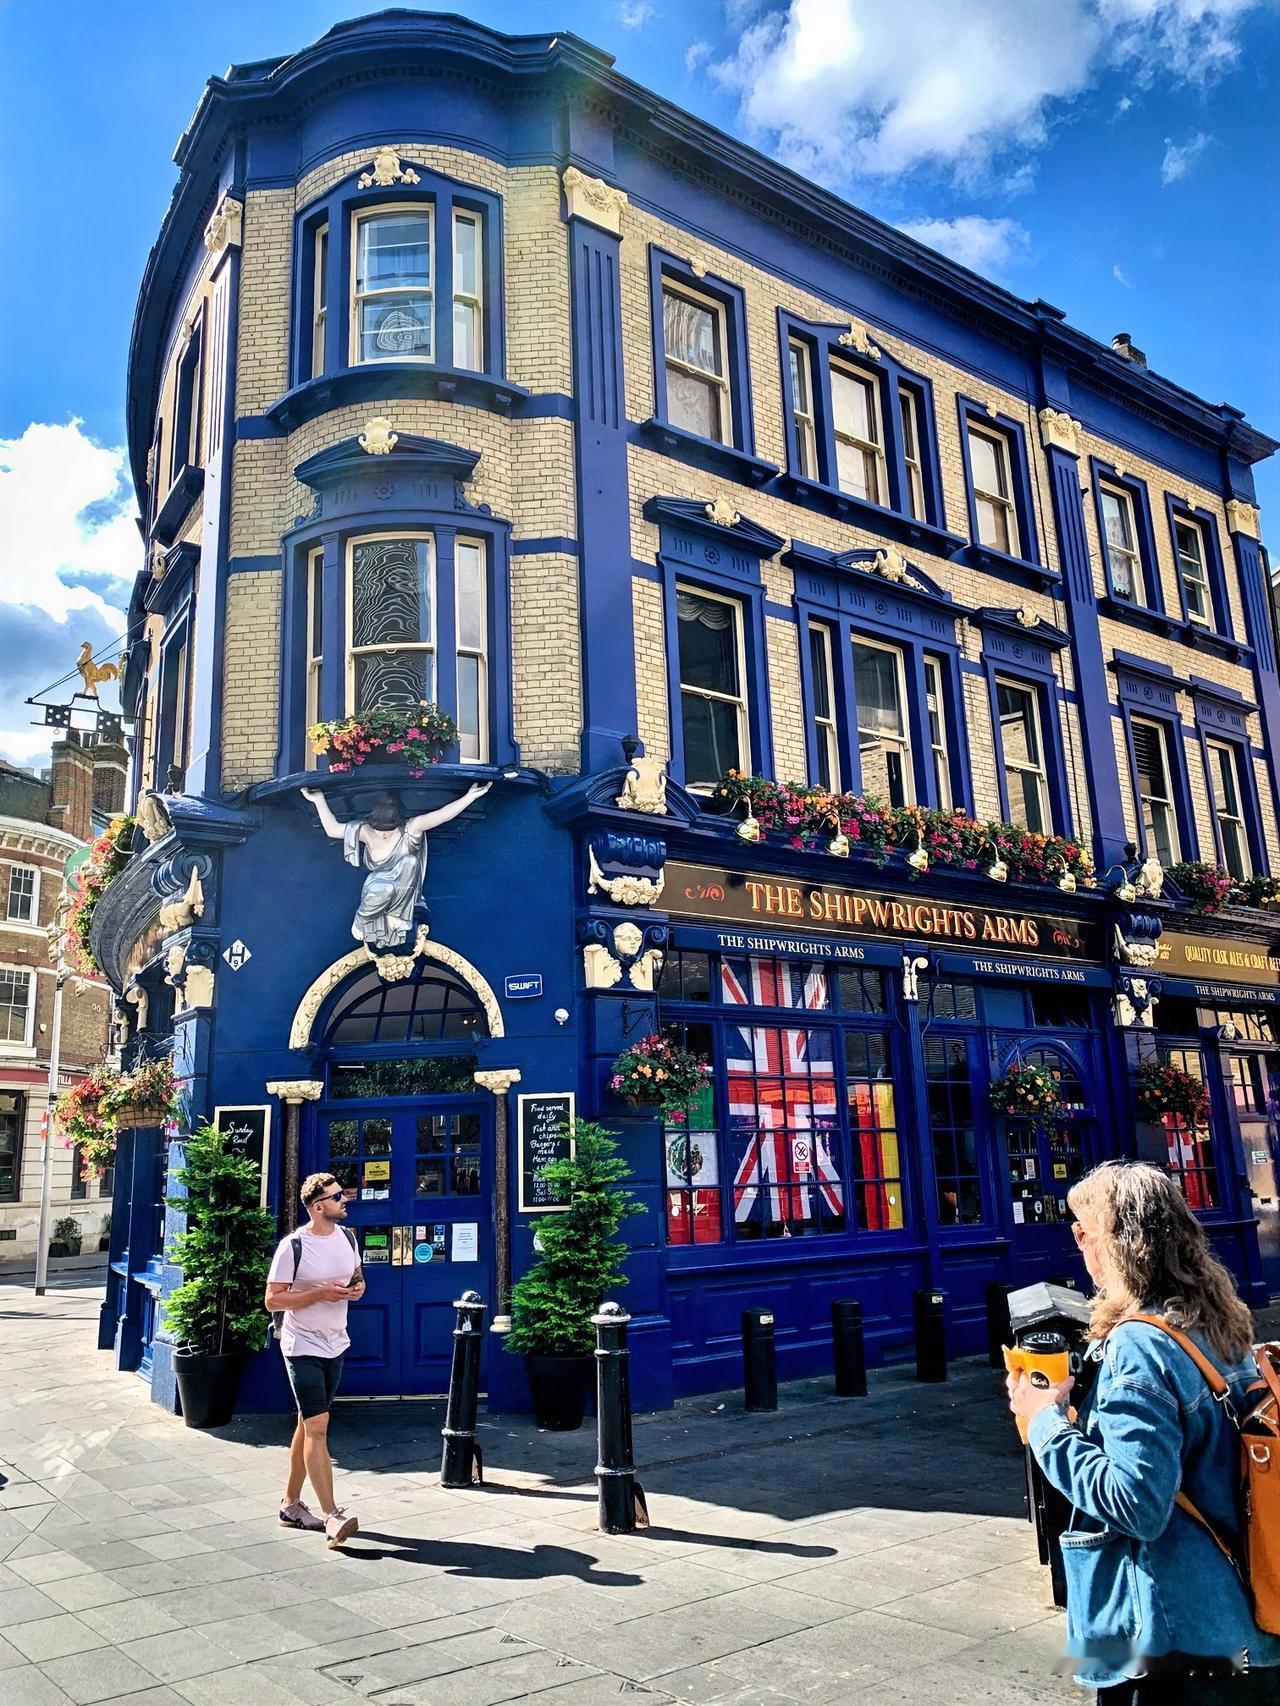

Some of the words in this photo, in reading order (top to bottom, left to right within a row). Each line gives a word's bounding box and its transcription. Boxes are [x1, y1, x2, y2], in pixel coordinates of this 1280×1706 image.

[745, 881, 804, 918] THE
[809, 890, 977, 940] SHIPWRIGHTS
[982, 914, 1040, 947] ARMS
[228, 946, 245, 963] H
[717, 934, 745, 948] THE
[747, 936, 832, 957] SHIPWRIGHTS
[834, 945, 865, 960] ARMS
[233, 960, 239, 968] 9
[1184, 945, 1211, 962] QUALITY
[1212, 948, 1229, 965] CASK
[1229, 951, 1244, 967] ALES
[1244, 953, 1251, 968] &
[1250, 954, 1269, 970] CRAFT
[973, 960, 994, 973] THE
[995, 962, 1060, 979] SHIPWRIGHTS
[1061, 970, 1085, 982] ARMS
[508, 981, 540, 991] SWIFT
[1194, 984, 1211, 996] THE
[1211, 986, 1258, 1000] SHIPWRIGHTS
[1258, 992, 1276, 1001] ARMS
[530, 1103, 545, 1113] Food
[545, 1102, 564, 1111] served
[536, 1111, 557, 1123] daily
[227, 1121, 254, 1140] Sunday
[532, 1122, 546, 1134] Fish
[537, 1147, 555, 1155] mash
